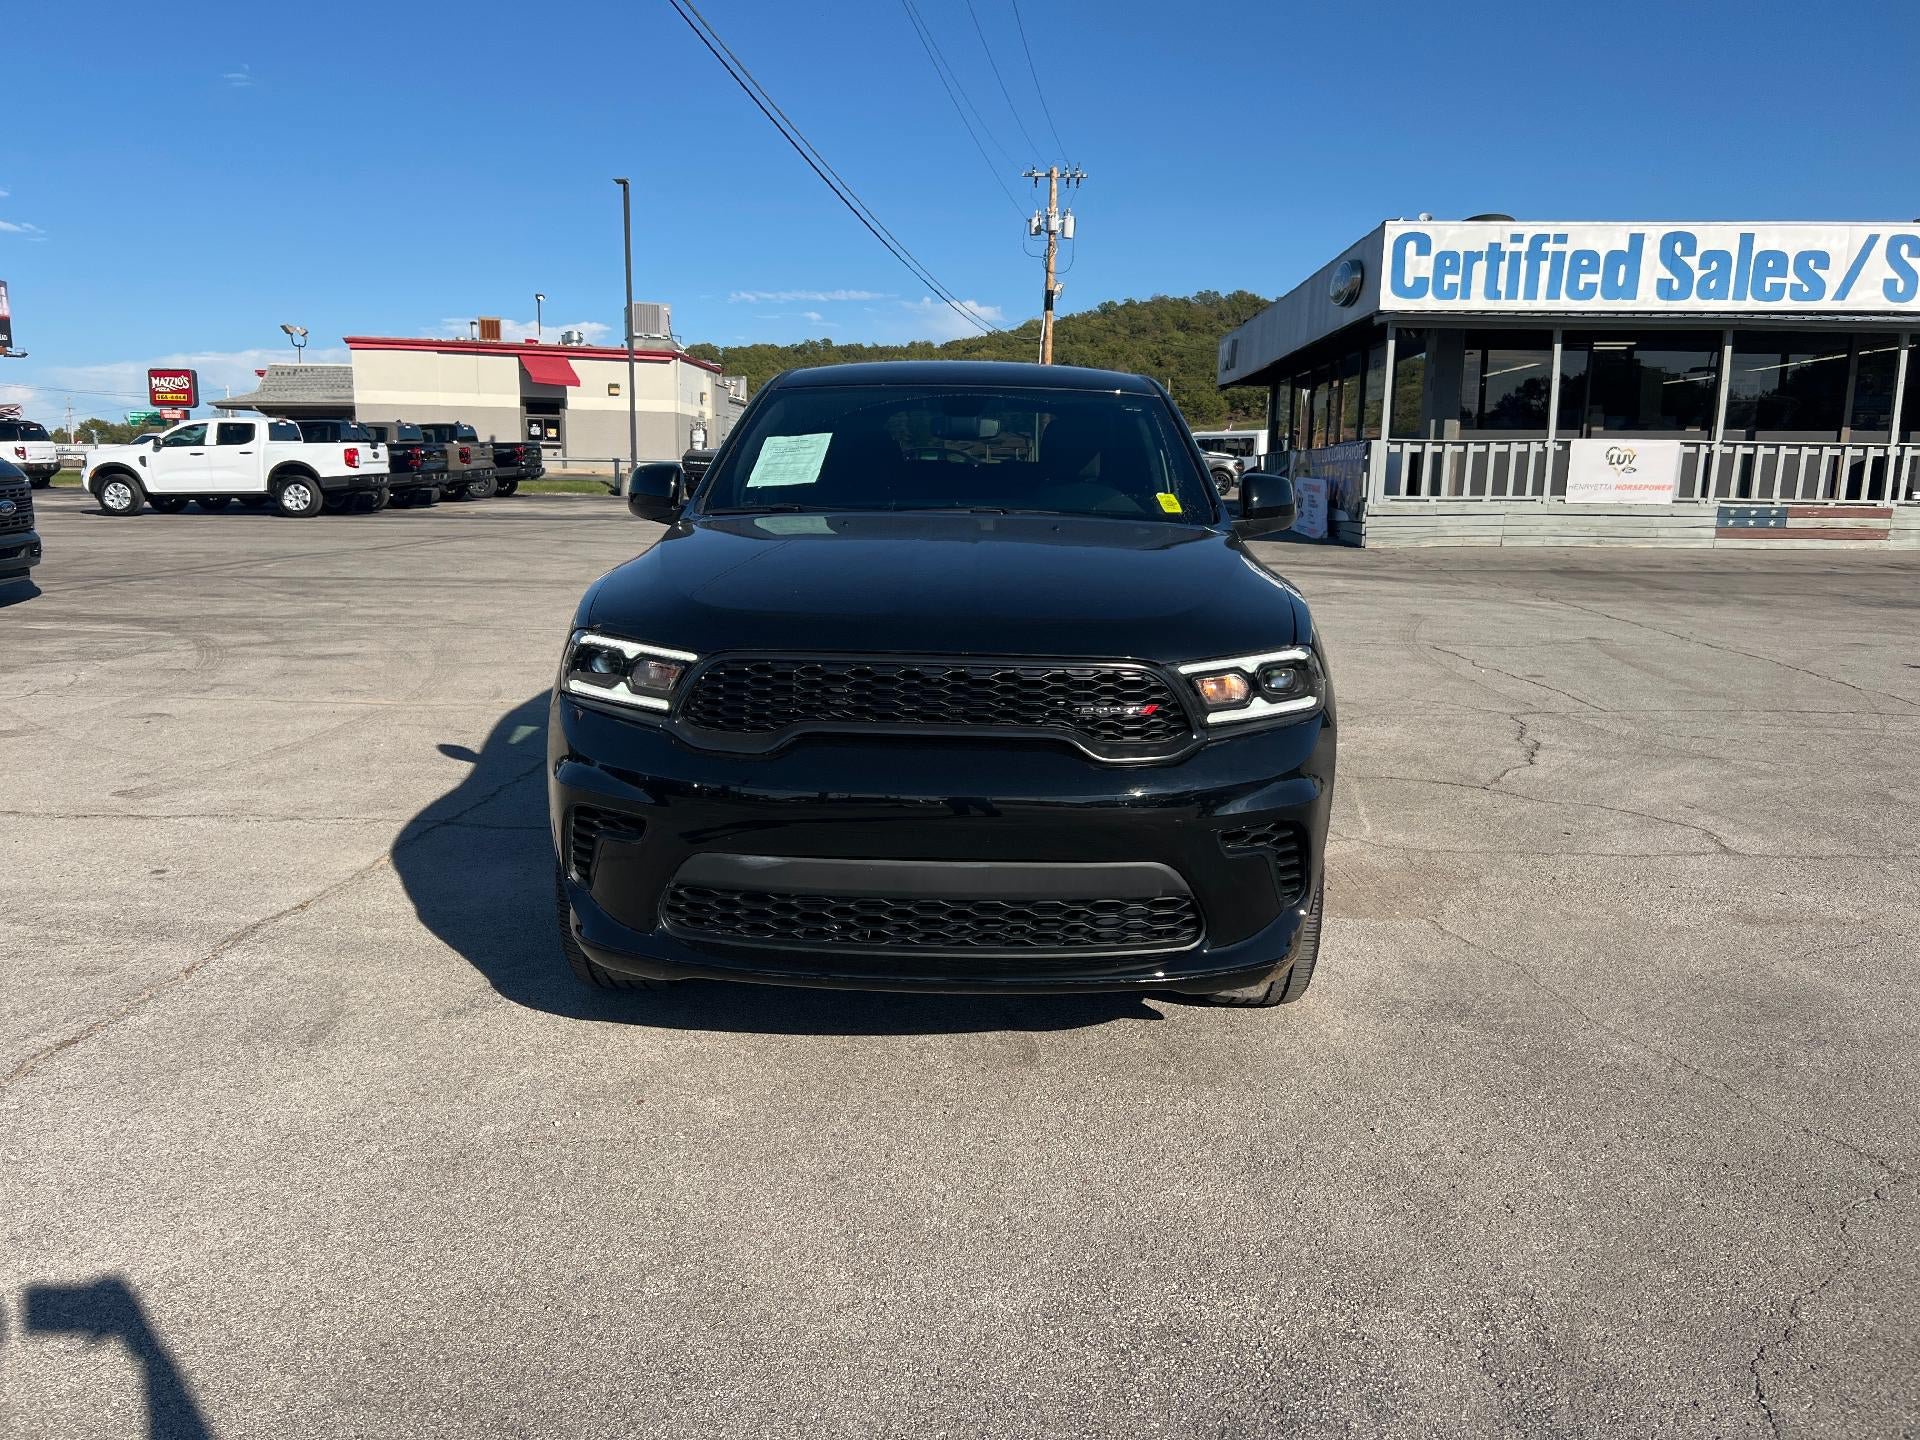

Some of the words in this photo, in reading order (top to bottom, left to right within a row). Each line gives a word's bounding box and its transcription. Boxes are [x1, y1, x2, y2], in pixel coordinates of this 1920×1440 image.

[1390, 231, 1645, 300] Certified
[150, 375, 189, 390] MAZZIO'S
[1608, 454, 1636, 465] LUV
[1568, 483, 1612, 491] HENRYETTA
[1615, 483, 1673, 491] HORSEPOWER
